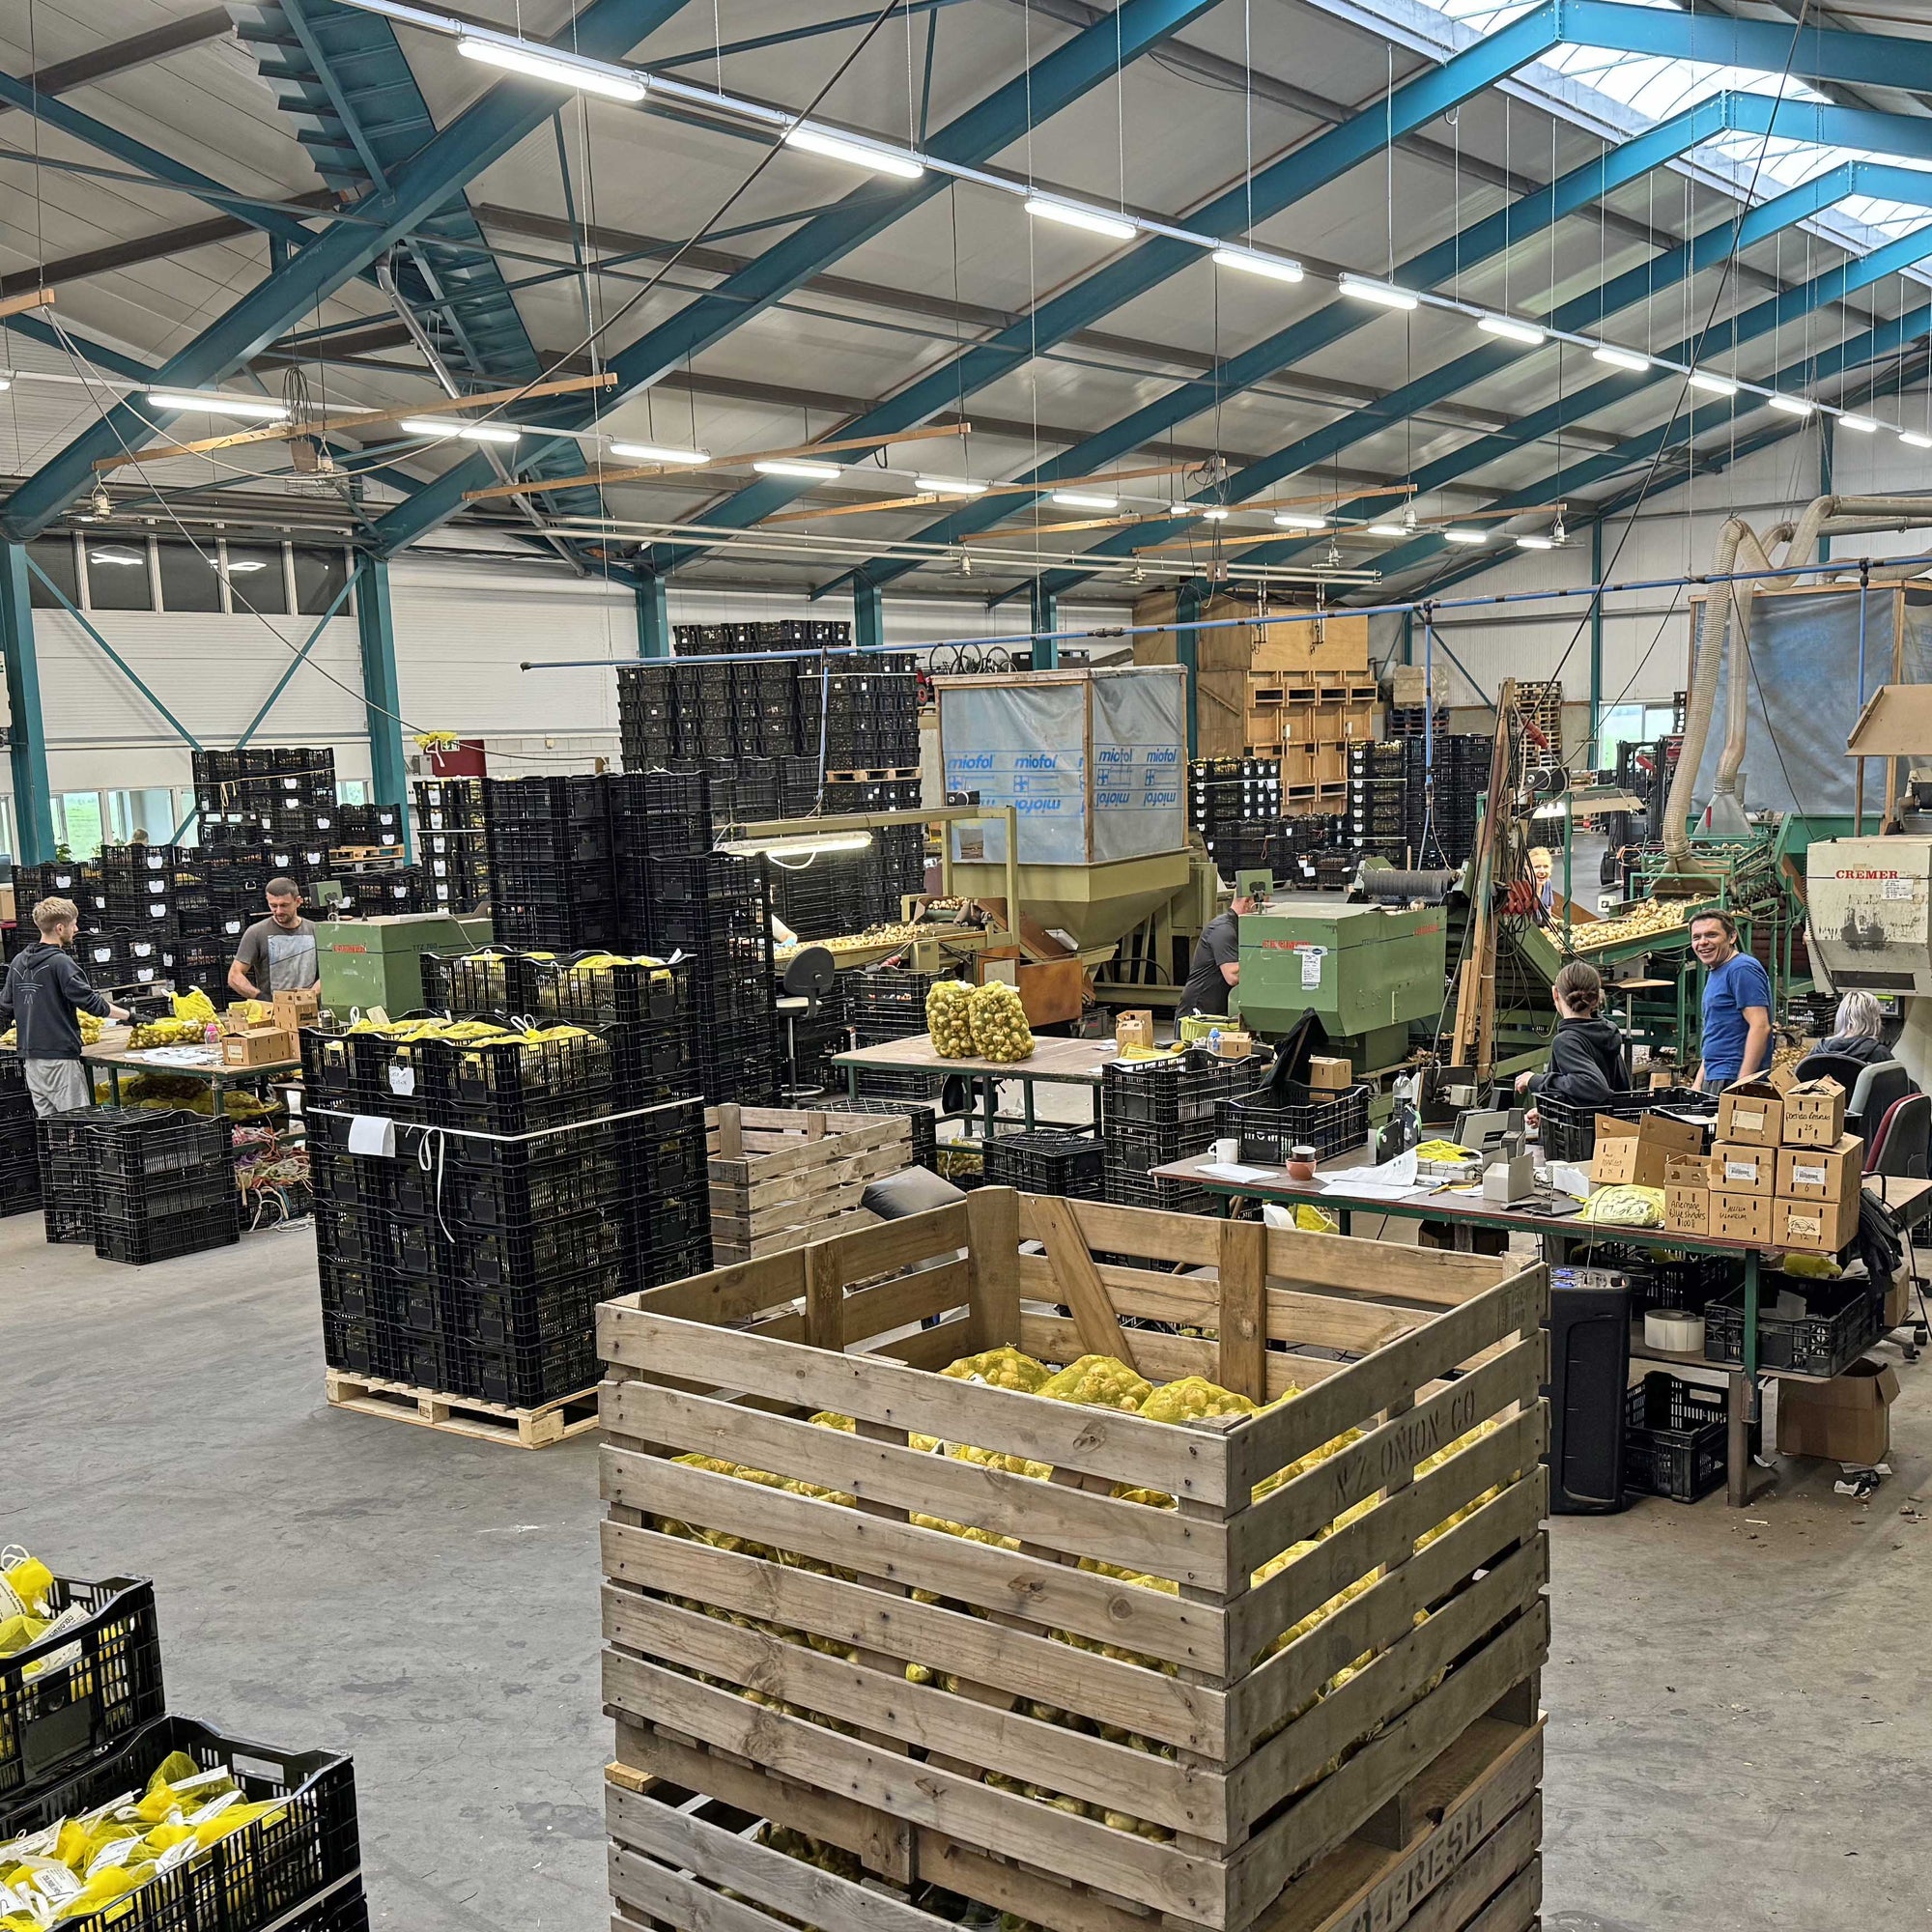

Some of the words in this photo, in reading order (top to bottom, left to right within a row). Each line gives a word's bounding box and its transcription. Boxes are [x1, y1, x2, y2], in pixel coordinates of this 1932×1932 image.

[949, 753, 993, 769] miofol
[1014, 753, 1058, 769] miofol
[1098, 747, 1133, 762] miofol
[1147, 748, 1177, 762] miofol
[1096, 792, 1130, 808] miofol
[1143, 792, 1177, 808] miofol
[1835, 869, 1899, 879] CREMER
[1380, 1408, 1439, 1478] ONION
[1451, 1387, 1475, 1434] CO
